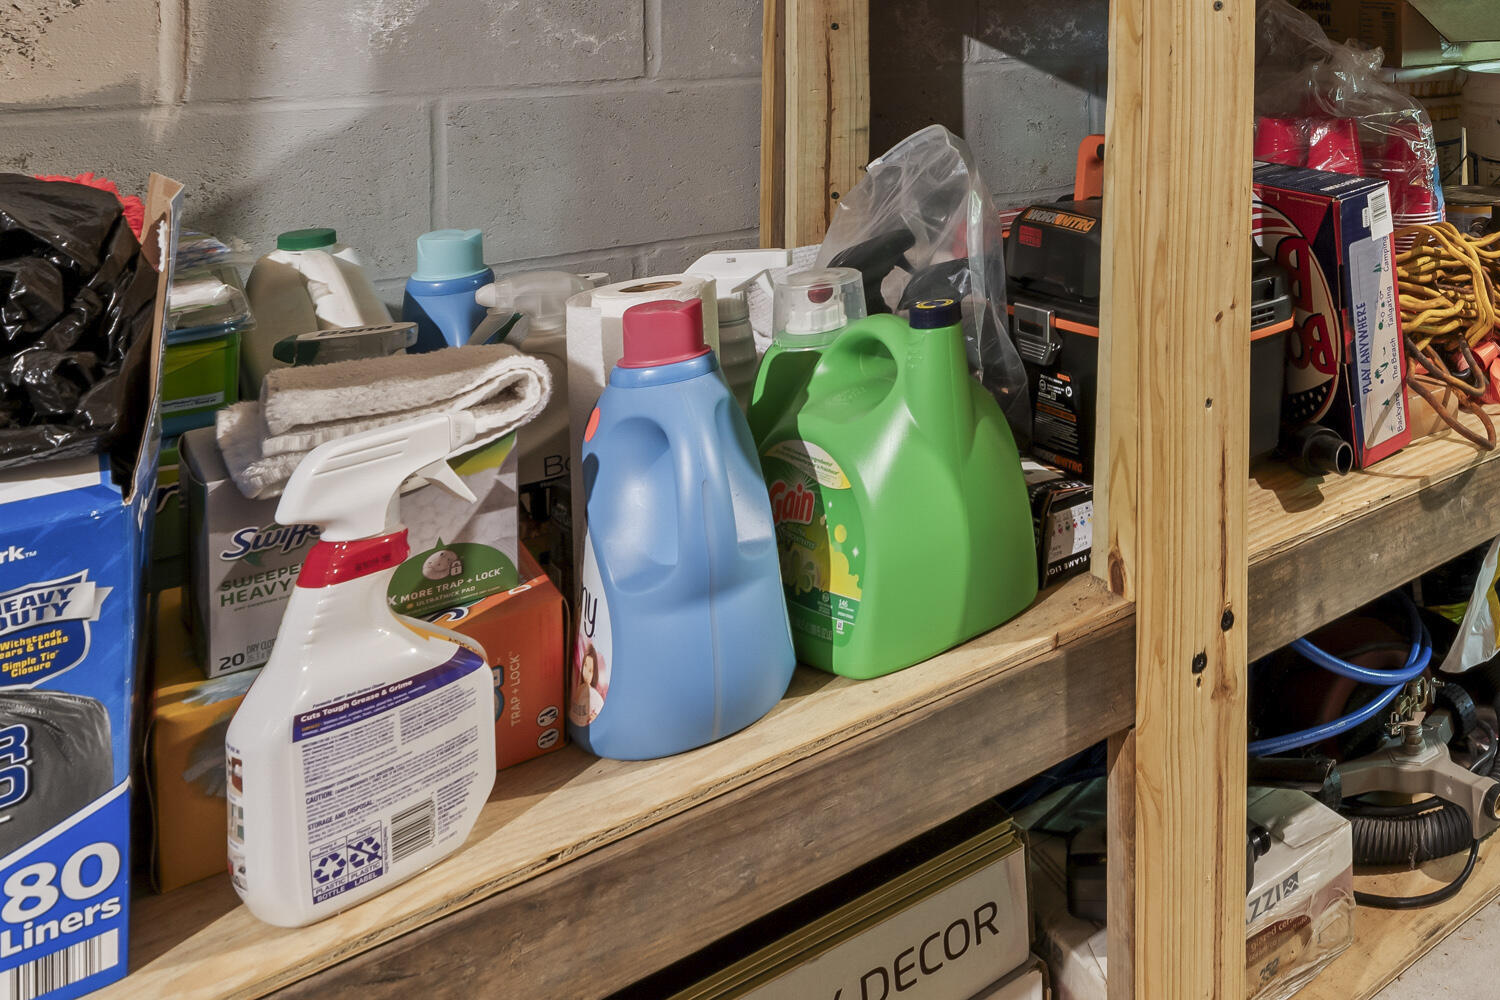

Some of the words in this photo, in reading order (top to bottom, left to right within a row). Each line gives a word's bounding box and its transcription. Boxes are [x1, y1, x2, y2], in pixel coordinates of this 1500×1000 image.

[1386, 285, 1395, 328] Tailgating
[1356, 301, 1370, 364] ANYWHERE
[1361, 368, 1373, 395] PLAY
[1395, 392, 1403, 432] Backyard
[769, 480, 815, 526] Gain
[220, 524, 321, 561] Swiffe
[1064, 554, 1088, 570] FLAME
[220, 564, 302, 592] SWEEPE
[400, 587, 433, 604] MORE
[437, 579, 464, 593] TRAP
[0, 586, 75, 616] EAVY
[220, 578, 292, 608] HEAVY
[416, 590, 459, 607] ULTRATHICK
[461, 585, 475, 595] PAD
[0, 629, 62, 651] Withstands
[0, 647, 23, 660] ears
[26, 643, 35, 653] &
[38, 635, 69, 650] Leaks
[1, 656, 37, 673] Simple
[10, 661, 52, 678] Closure
[219, 653, 245, 671] 20
[300, 712, 321, 723] Cuts
[322, 702, 350, 717] Tough
[351, 692, 380, 707] Grease
[389, 679, 414, 693] Grime
[510, 697, 520, 727] TRAP
[307, 814, 333, 831] STORAGE
[334, 811, 346, 820] AND
[1, 842, 121, 924] 80
[350, 862, 380, 880] PLASTIC
[354, 871, 378, 887] LABEL
[315, 878, 347, 895] PLASTIC
[317, 885, 346, 902] BOTTLE
[0, 896, 121, 959] Liners
[860, 901, 1000, 1000] DECOR
